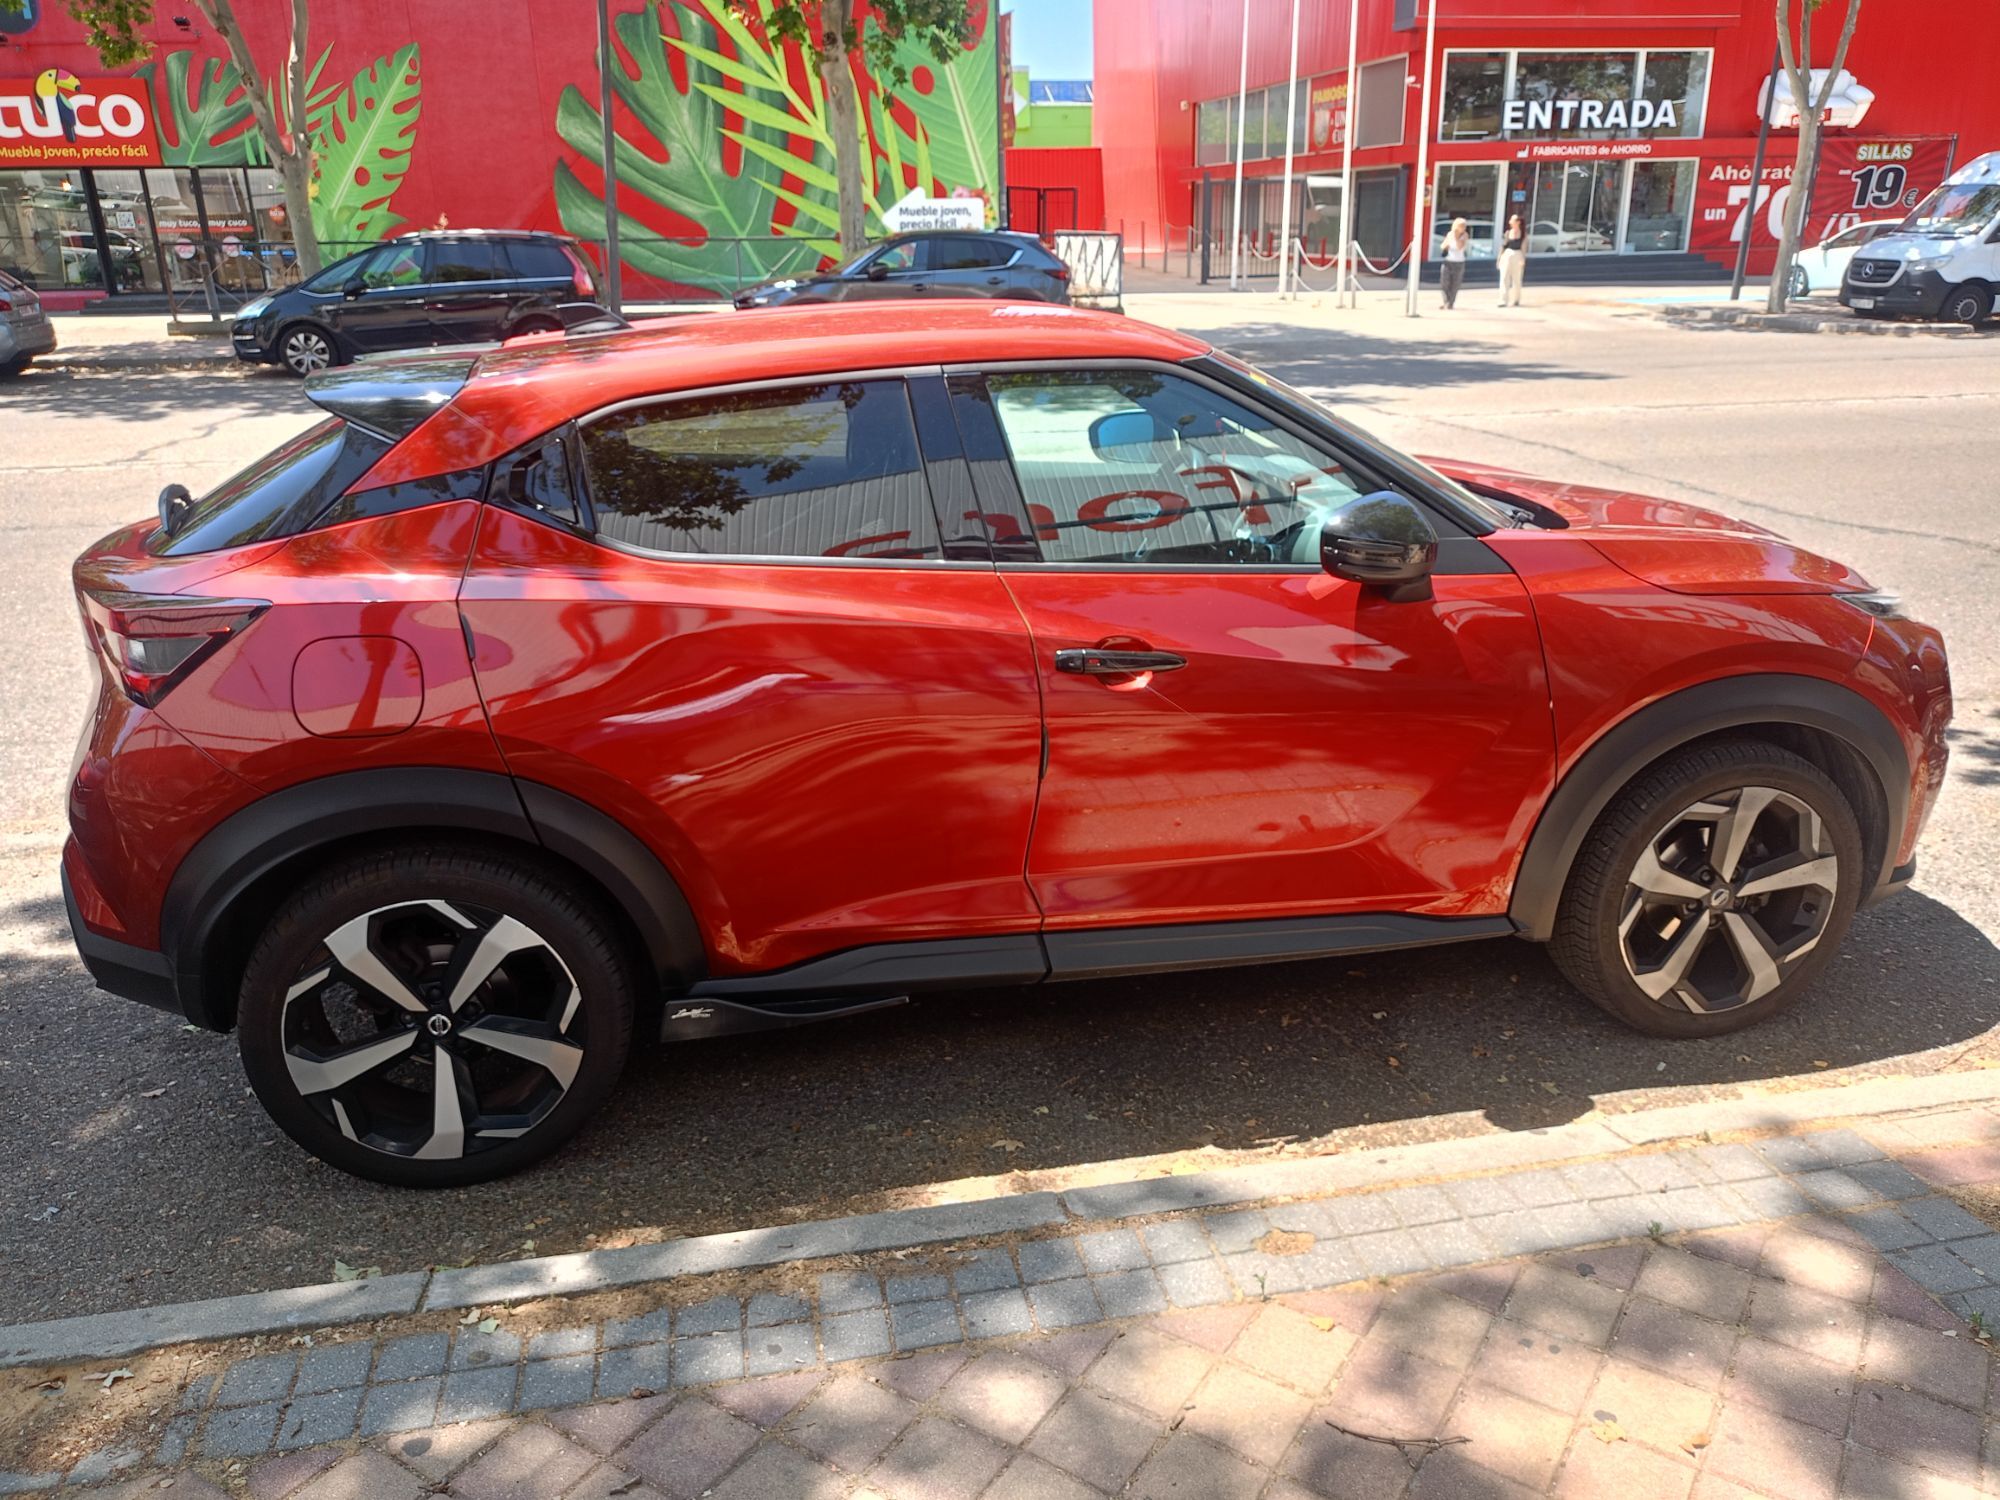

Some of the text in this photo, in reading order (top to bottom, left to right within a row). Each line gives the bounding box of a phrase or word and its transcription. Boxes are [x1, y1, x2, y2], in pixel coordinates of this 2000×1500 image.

[1502, 99, 1677, 130] ENTRADA
[43, 144, 80, 160] joven,
[82, 144, 119, 160] precio
[121, 144, 148, 157] fácil
[1533, 144, 1652, 156] FABRICANTES de AHORRO
[1856, 143, 1913, 161] SILLAS
[899, 205, 972, 217] Mueble joven,
[1704, 208, 1727, 221] un
[900, 219, 933, 231] precio
